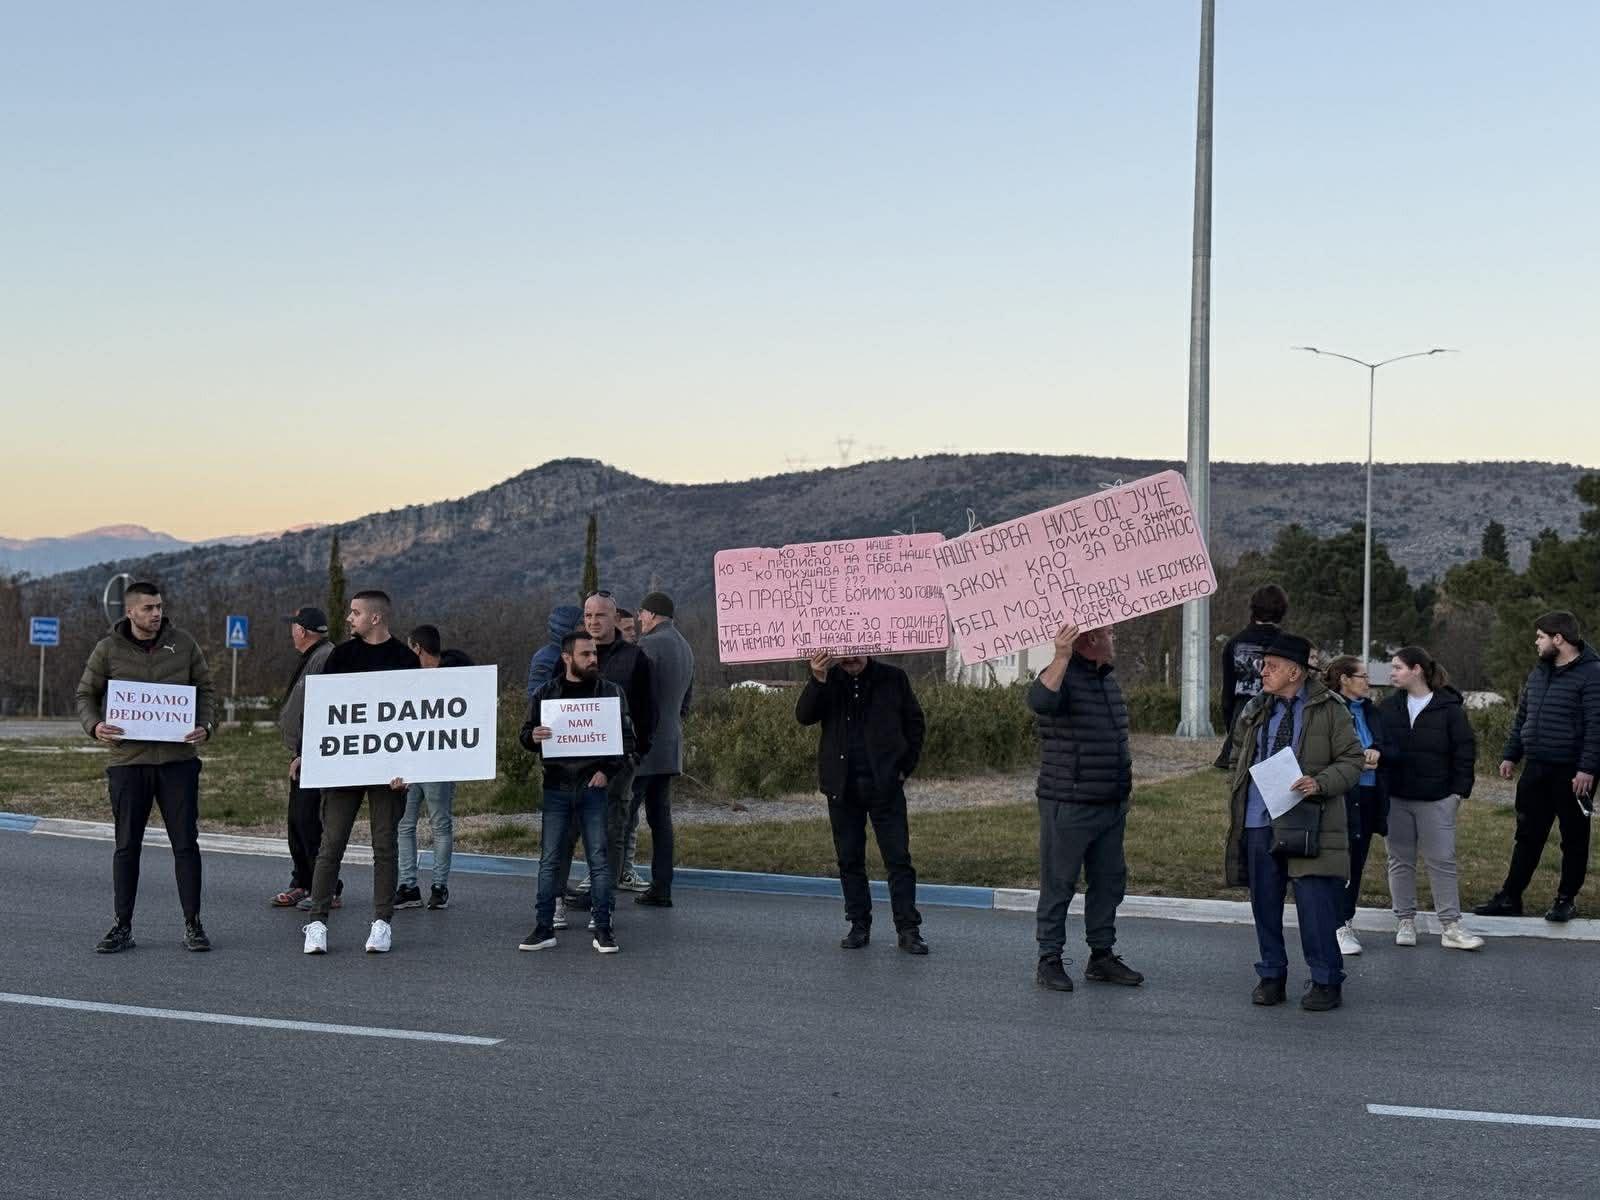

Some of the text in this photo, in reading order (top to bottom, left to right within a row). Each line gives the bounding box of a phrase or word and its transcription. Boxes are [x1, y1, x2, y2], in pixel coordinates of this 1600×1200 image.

[933, 481, 1176, 569] НАША БОРБА НИЈЕ ОД ЈУЧЕ
[1047, 525, 1110, 552] ТОЛИКО
[1119, 518, 1136, 532] СЕ
[778, 548, 795, 560] КО
[803, 545, 817, 558] ЈЕ
[823, 542, 855, 556] ОТЕО
[945, 515, 1195, 601] ЗАКОН КАО ЗА ВАЛДАНОС
[718, 563, 735, 577] КО
[740, 561, 754, 572] ЈЕ
[767, 556, 831, 570] ПРЕПИСАО
[843, 554, 860, 564] НА
[865, 551, 892, 563] СЕБЕ
[755, 562, 913, 581] КО ПОКУШАВА ДА ПРОДА
[788, 577, 840, 591] НАШЕ
[1033, 568, 1080, 596] САД
[717, 590, 744, 611] ЗА
[748, 588, 814, 610] ПРАВДУ
[821, 589, 840, 603] СЕ
[845, 586, 896, 603] БОРИМО
[954, 609, 998, 636] ЂЕД
[1003, 596, 1051, 623] МОЈ
[1062, 573, 1130, 608] ПРАВДУ
[798, 607, 808, 618] И
[1040, 609, 1064, 625] МИ
[719, 622, 761, 638] ТРЕБА
[767, 620, 785, 634] ЛИ
[792, 619, 803, 633] И
[812, 618, 856, 634] ПОСЛЕ
[973, 641, 986, 660] У
[993, 620, 1063, 655] АМАНЕТ
[1072, 608, 1116, 632] НАМ
[720, 639, 739, 653] МИ
[741, 634, 786, 651] НЕМАМО
[791, 632, 812, 647] КУД
[819, 631, 853, 644] НАЗАД
[857, 630, 881, 643] ИЗА
[886, 630, 898, 644] ЈЕ
[115, 690, 189, 707] NE DAMO
[560, 703, 600, 713] VRATITE
[109, 708, 192, 724] ĐEDOVINU
[328, 697, 467, 725] NE DAMO
[568, 718, 593, 728] NAM
[319, 727, 480, 757] ĐEDOVINU
[557, 731, 608, 744] ZEMLJIŠTE
